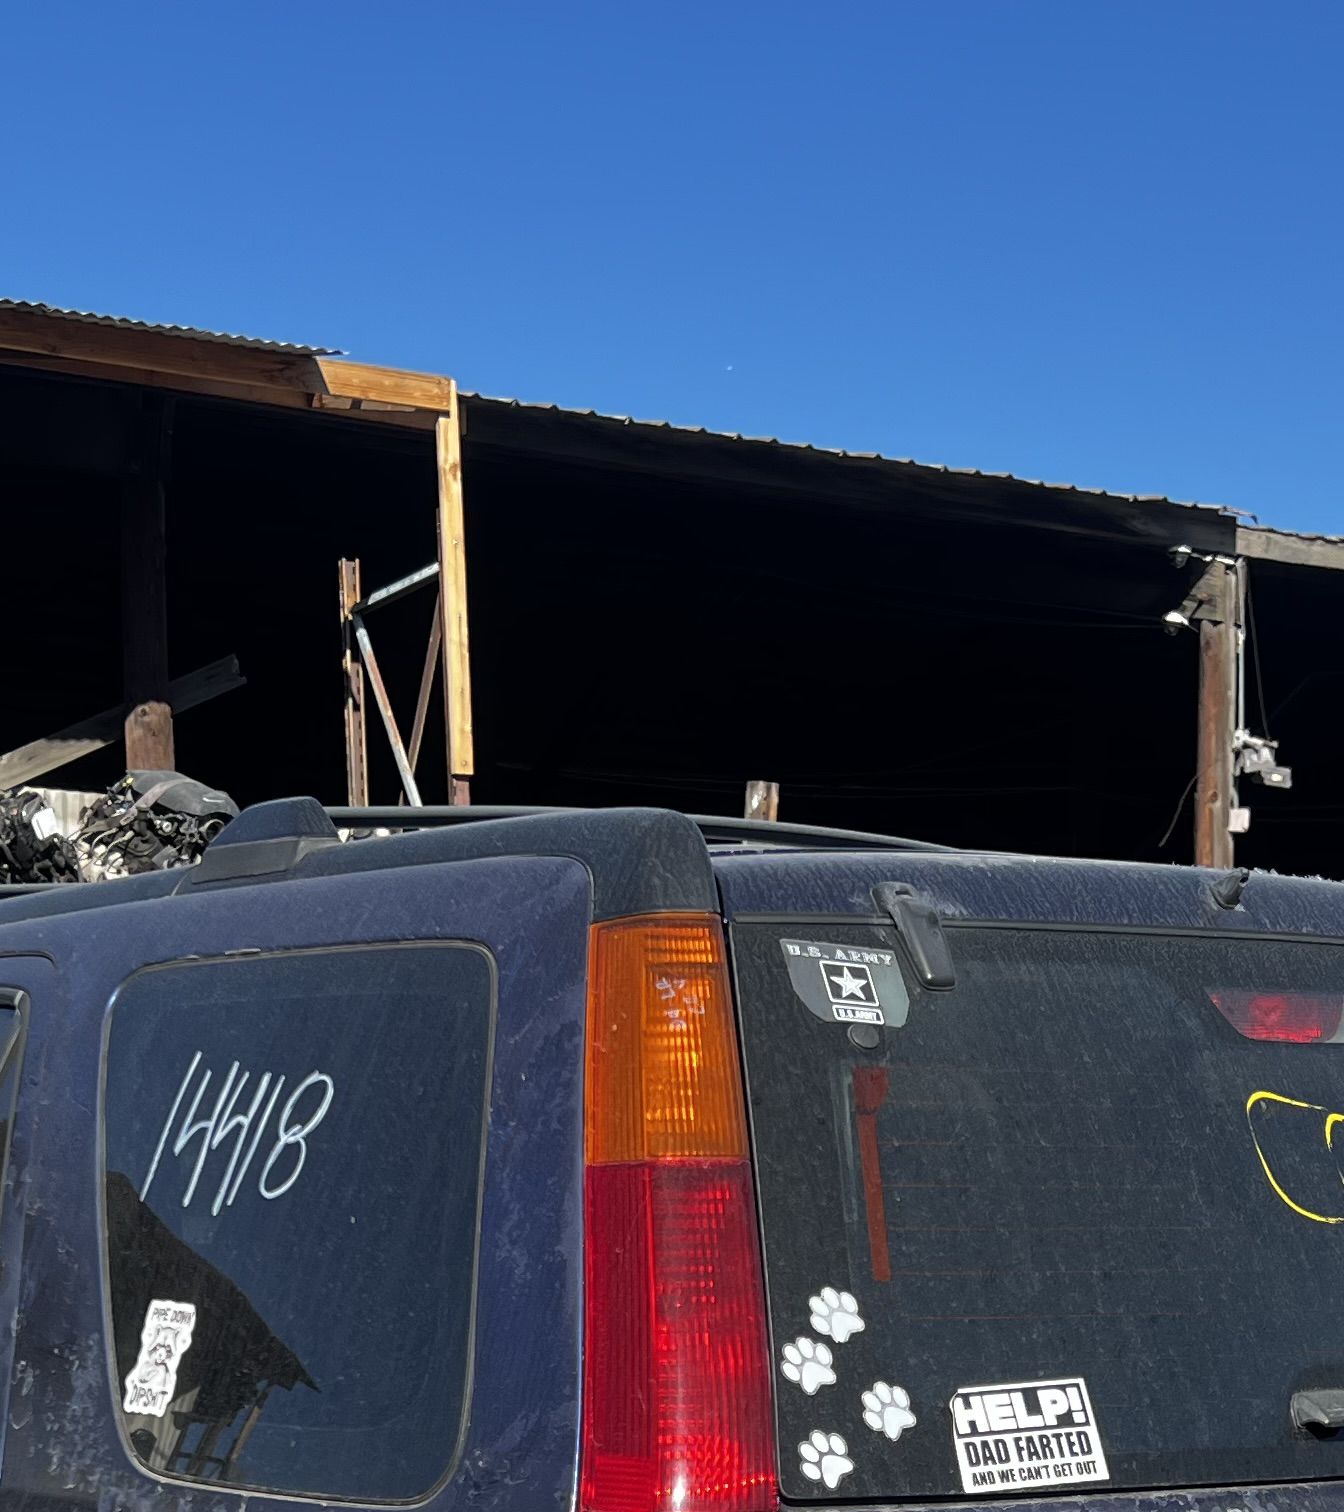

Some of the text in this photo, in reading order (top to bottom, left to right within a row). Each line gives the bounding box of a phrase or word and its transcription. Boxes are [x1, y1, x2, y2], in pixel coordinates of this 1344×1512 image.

[786, 943, 892, 967] U.S. ARMY
[139, 1050, 335, 1217] 14418
[954, 1386, 1087, 1435] HELP!
[963, 1430, 1094, 1468] DAD FARTED
[971, 1460, 1098, 1487] AND WE CAN'T GET OUT
